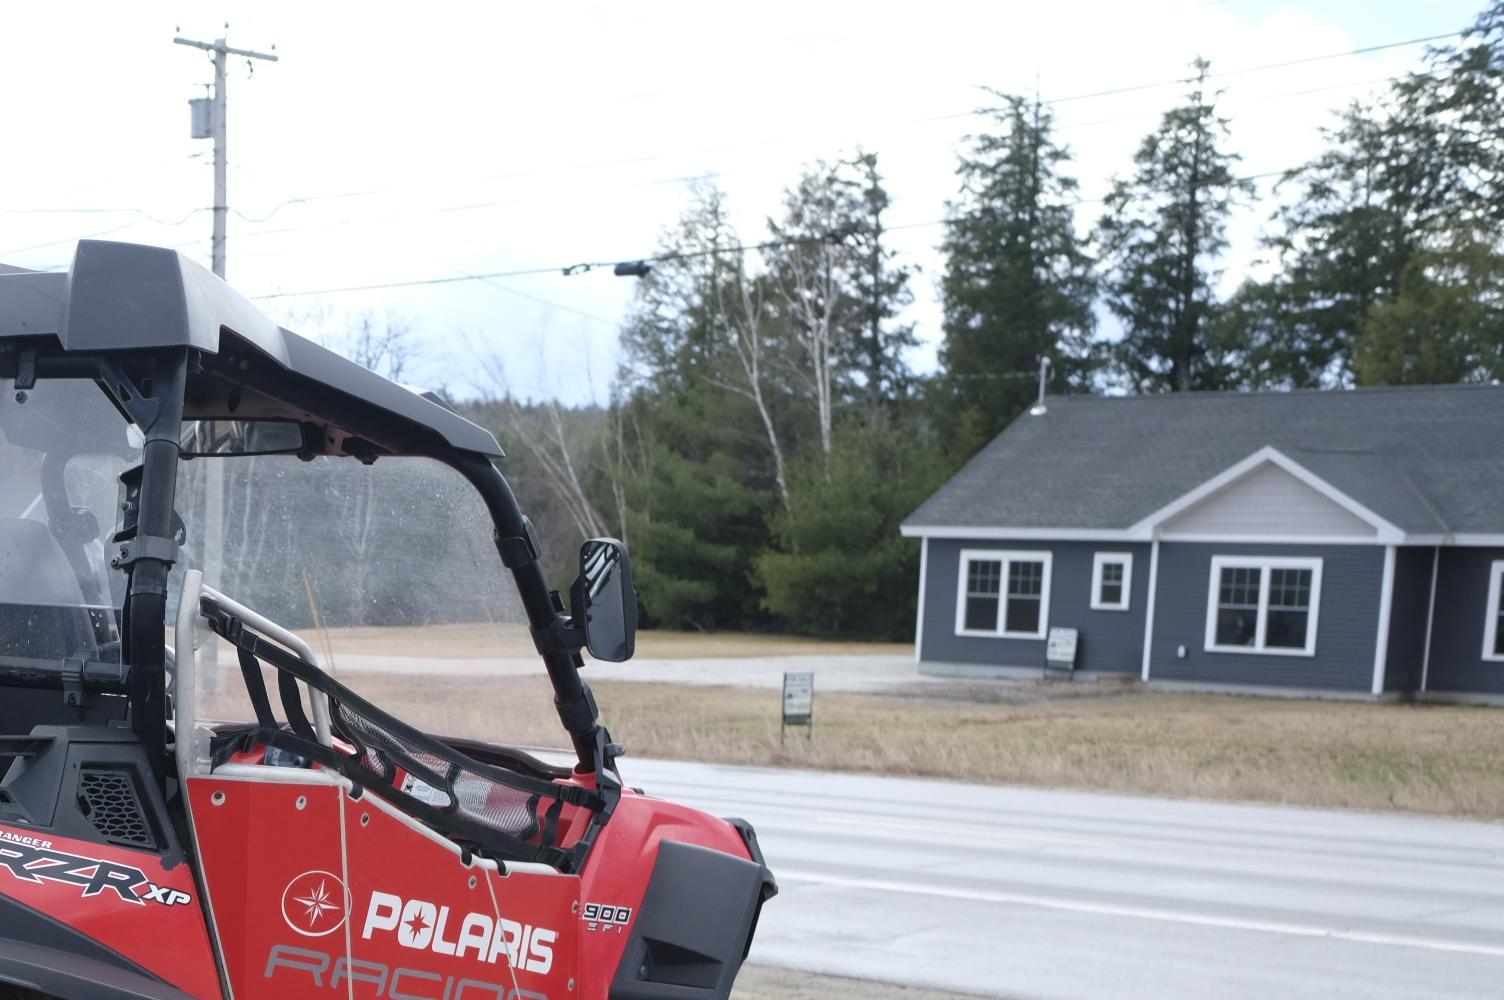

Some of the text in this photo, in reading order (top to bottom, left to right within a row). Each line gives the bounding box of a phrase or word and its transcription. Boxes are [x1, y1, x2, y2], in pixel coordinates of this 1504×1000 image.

[142, 882, 192, 906] XP
[582, 902, 632, 925] 900
[362, 890, 557, 974] POLARIS
